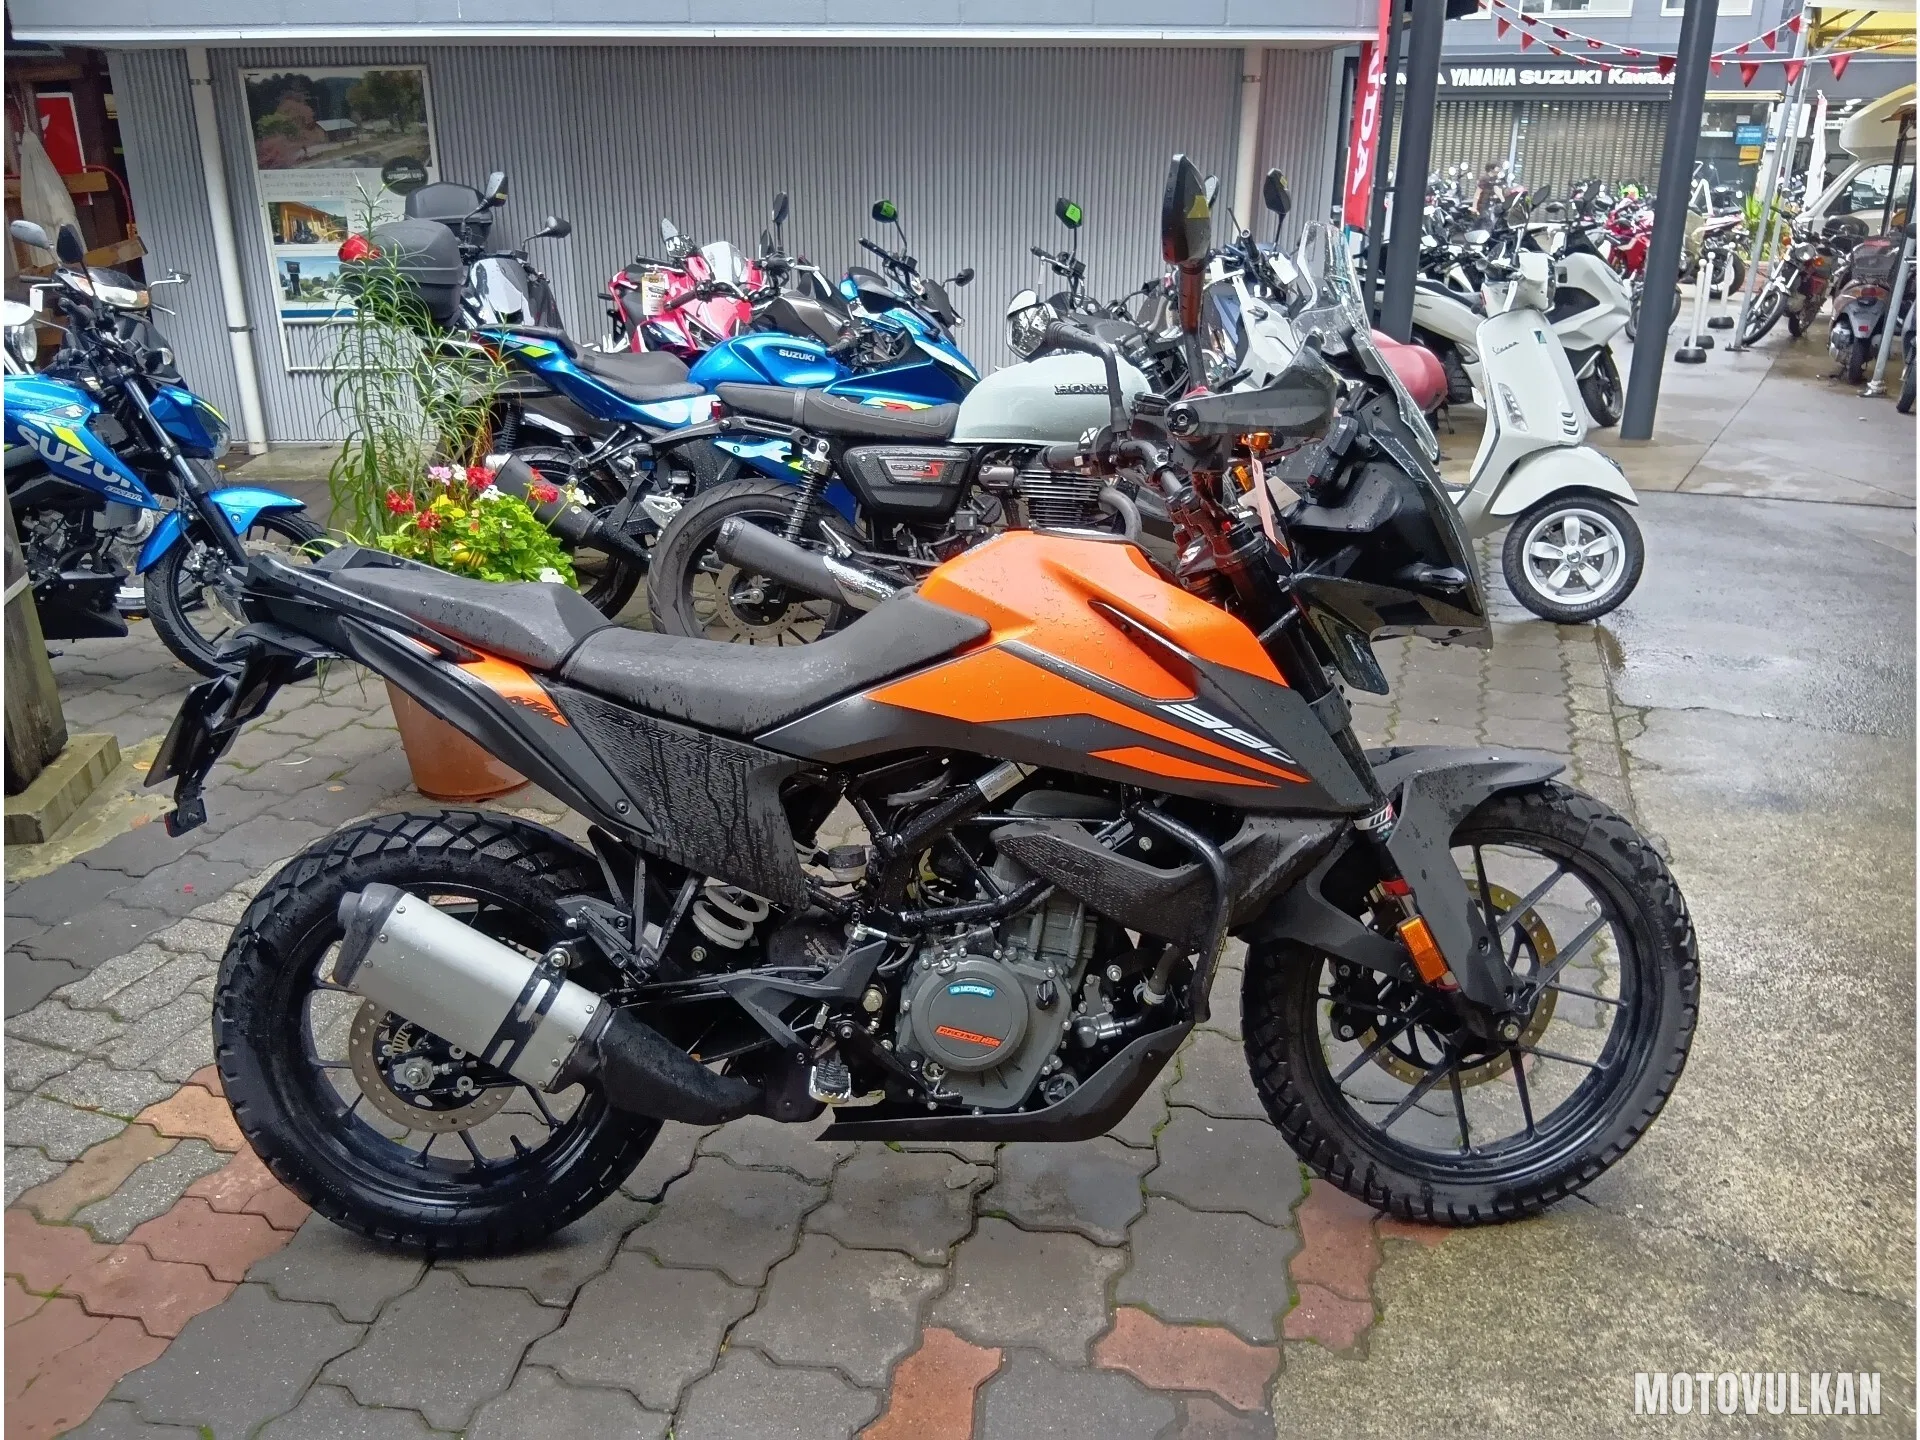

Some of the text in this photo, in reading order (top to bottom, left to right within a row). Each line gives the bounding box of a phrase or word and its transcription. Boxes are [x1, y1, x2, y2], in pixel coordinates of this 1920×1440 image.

[1450, 68, 1517, 86] YAMAHA
[1519, 69, 1603, 85] SUZUKI
[778, 348, 816, 362] SUZUKI
[1054, 383, 1111, 396] HOND
[1155, 703, 1297, 765] 390
[960, 985, 993, 997] MOTOREX
[938, 1027, 982, 1043] RACING
